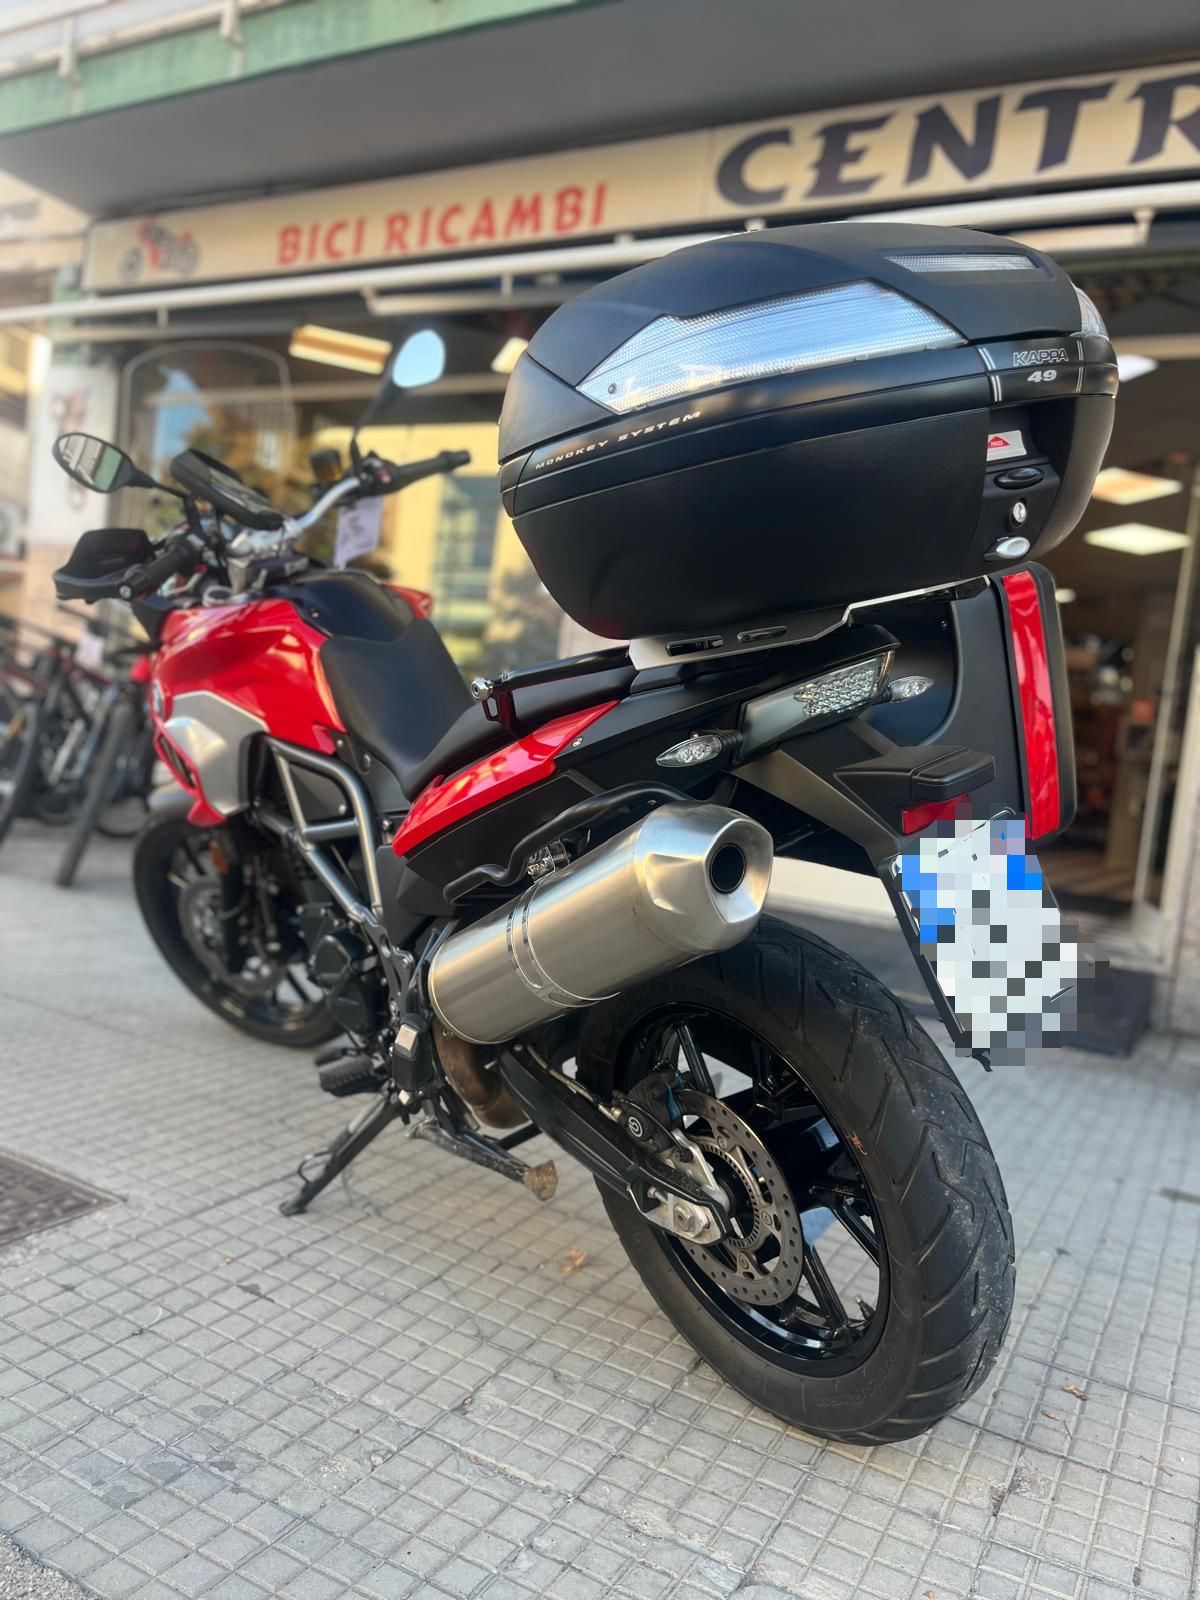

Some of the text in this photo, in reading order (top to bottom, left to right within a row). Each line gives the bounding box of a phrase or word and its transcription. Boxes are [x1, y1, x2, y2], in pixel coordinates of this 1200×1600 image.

[716, 73, 1200, 207] CENTR
[276, 181, 607, 266] BICI RICAMBI
[1013, 348, 1068, 367] KAPPA
[1027, 369, 1057, 382] 49
[535, 411, 701, 470] MONOKEY SYSTEM
